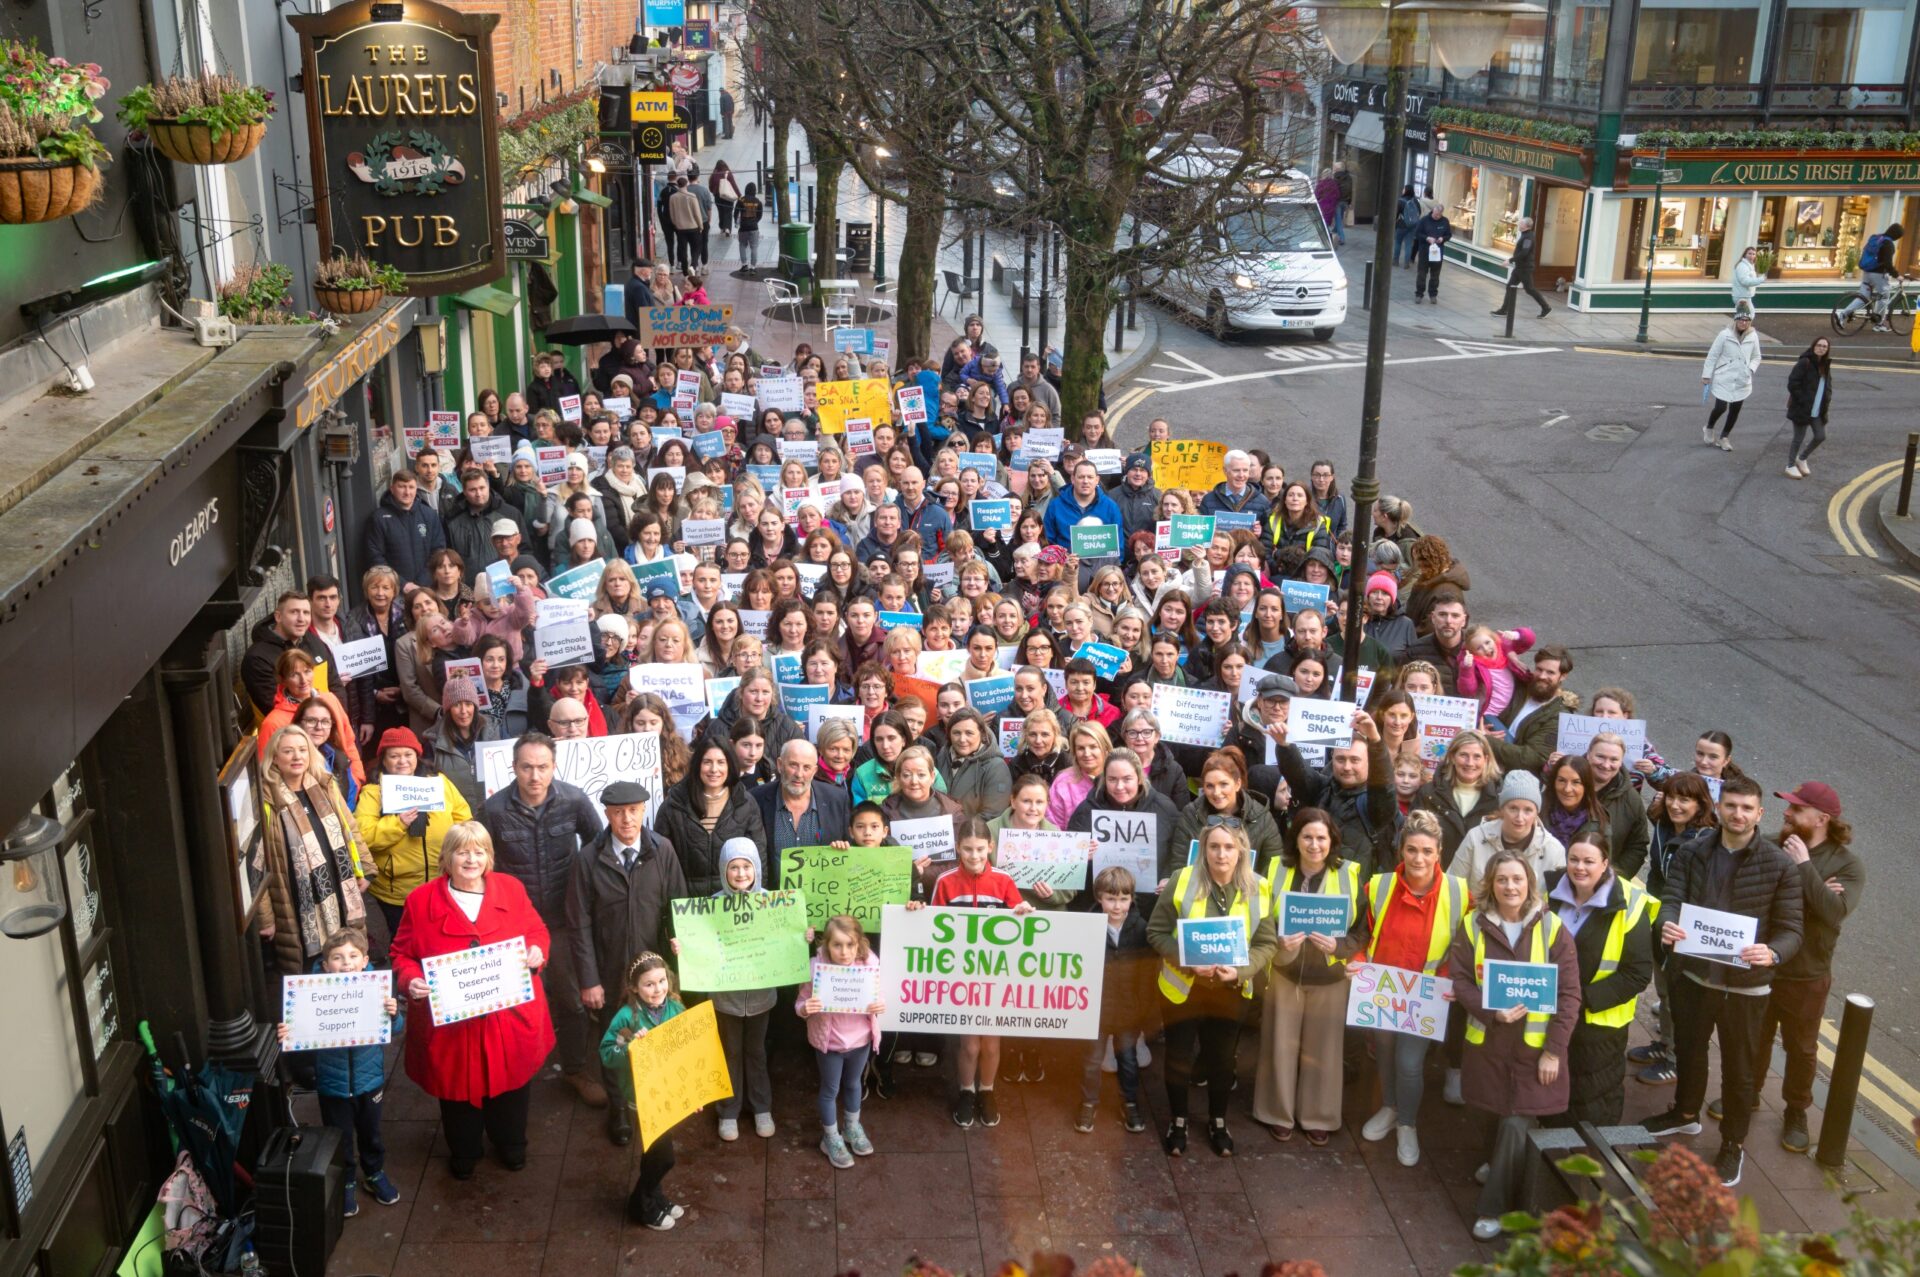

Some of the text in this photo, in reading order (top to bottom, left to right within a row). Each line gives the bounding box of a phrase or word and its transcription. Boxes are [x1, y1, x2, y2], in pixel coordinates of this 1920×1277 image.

[366, 45, 428, 61] THE
[320, 74, 477, 115] LAURELS
[674, 85, 700, 95] TRAVEL
[1334, 84, 1375, 105] COYNE &
[636, 102, 668, 111] ATM
[1470, 141, 1557, 170] QUILLS IRISH JEWELLERY
[391, 165, 430, 178] 1918
[1735, 165, 1799, 184] QUILLS
[1804, 165, 1854, 181] IRISH
[362, 215, 460, 247] PUB
[649, 307, 723, 322] CUT DOWN
[666, 321, 689, 332] COST
[652, 333, 700, 346] NOT OUR
[1027, 439, 1056, 447] Respect
[1153, 441, 1223, 454] STOP THE
[1161, 453, 1199, 465] CUTS
[977, 507, 1005, 516] Respect
[982, 514, 1001, 522] SNAs
[169, 497, 218, 567] O'LEARY'S
[1177, 522, 1209, 532] Respect
[1077, 533, 1112, 542] Respect
[1182, 531, 1204, 540] SNAs
[1083, 540, 1106, 550] SNAs
[559, 572, 601, 593] Respect
[1288, 587, 1321, 598] Respect
[1293, 597, 1315, 607] SNAs
[541, 635, 587, 649] Our schools
[342, 647, 382, 662] Our schools
[545, 644, 587, 658] need SNAs
[1086, 645, 1119, 664] Respect
[346, 655, 382, 669] need SNAs
[642, 674, 694, 687] Respect
[797, 695, 826, 703] schools
[974, 690, 988, 698] Our
[977, 698, 995, 706] need
[1176, 700, 1210, 711] Different
[1170, 711, 1213, 723] Needs Equal
[1301, 711, 1345, 724] Respect
[1440, 709, 1463, 719] Needs
[1178, 723, 1201, 733] Rights
[1307, 723, 1336, 735] SNAs
[1566, 717, 1590, 733] ALL
[395, 784, 435, 793] Respect
[402, 793, 429, 802] SNAs
[900, 829, 950, 841] Our schools
[1022, 831, 1032, 839] My
[1094, 816, 1149, 843] SNA
[925, 839, 949, 849] SNAs
[672, 897, 720, 916] WHAT
[723, 893, 753, 912] OUR
[1290, 906, 1344, 915] Our schools
[1291, 916, 1341, 925] need SNAs
[932, 913, 1051, 947] STOP
[1693, 919, 1745, 940] Respect
[1192, 930, 1237, 942] Respect
[1201, 943, 1232, 953] SNAs
[1700, 935, 1734, 951] SNAs
[452, 959, 502, 978] Every child
[903, 946, 1083, 980] THE SNA CUTS
[458, 973, 501, 990] Deserves
[831, 976, 849, 984] Every
[1356, 964, 1436, 1001] SAVE
[1498, 974, 1548, 987] Respect
[311, 990, 364, 1003] Every child
[464, 987, 500, 1002] Support
[900, 979, 1089, 1011] SUPPORT ALL KIDS
[1506, 987, 1539, 999] SNAs
[315, 1006, 359, 1017] Deserves
[318, 1020, 356, 1032] Support
[899, 1012, 958, 1026] SUPPORTED
[960, 1014, 973, 1026] BY
[995, 1016, 1032, 1028] MARTIN
[1034, 1017, 1069, 1029] GRADY
